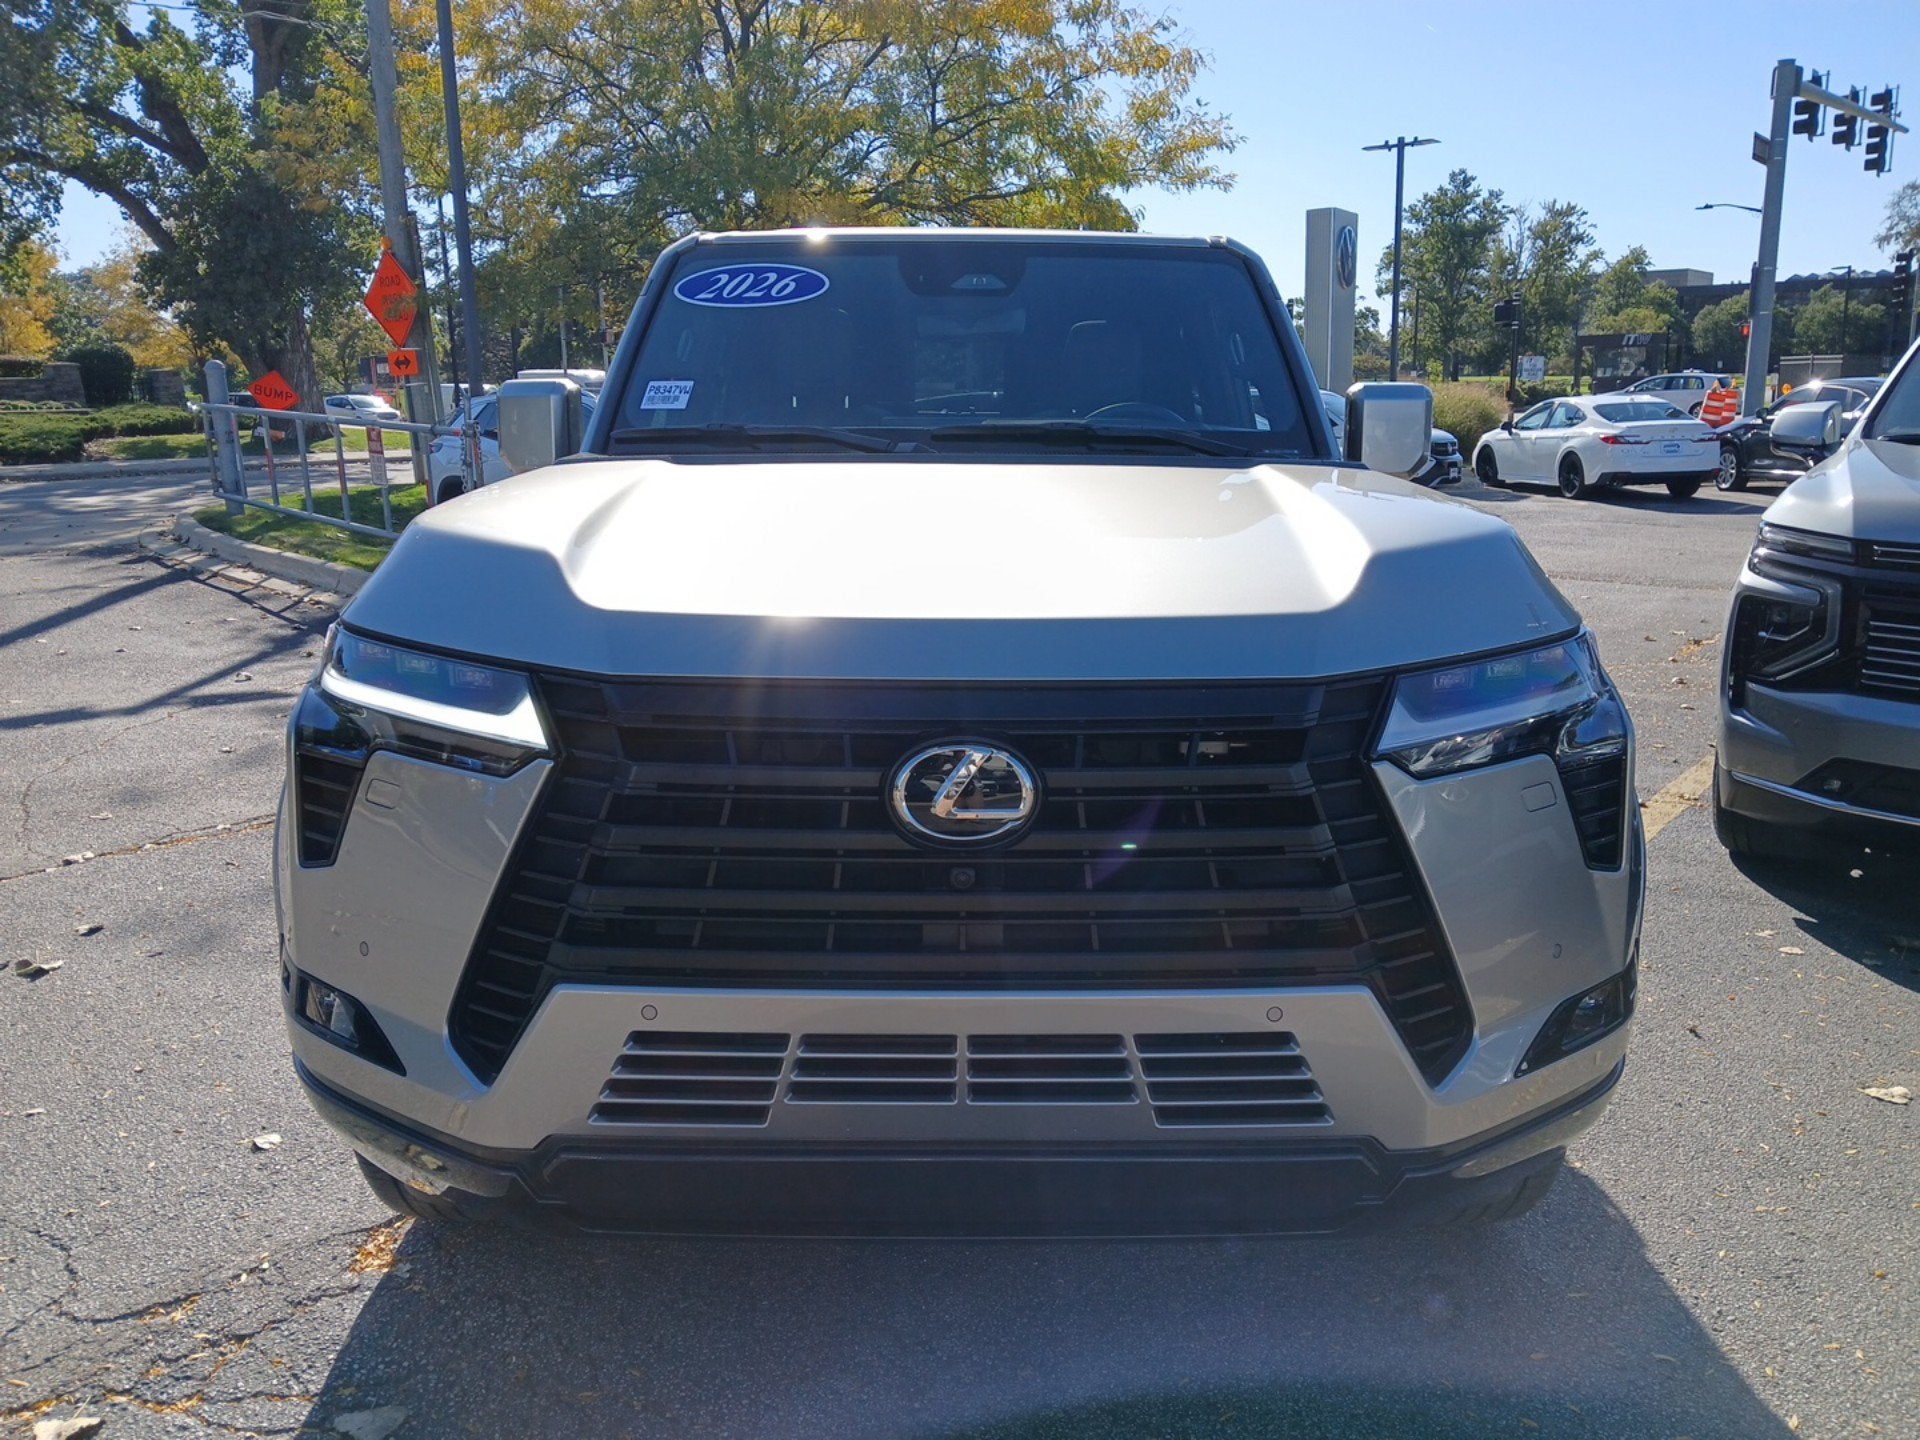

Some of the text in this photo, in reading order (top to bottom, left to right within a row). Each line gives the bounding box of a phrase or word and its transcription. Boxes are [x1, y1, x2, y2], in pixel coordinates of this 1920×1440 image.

[379, 275, 401, 288] ROAD
[693, 271, 807, 300] 2026
[1622, 333, 1652, 345] ITW
[254, 383, 293, 402] BUMP
[647, 384, 691, 395] P8347VW
